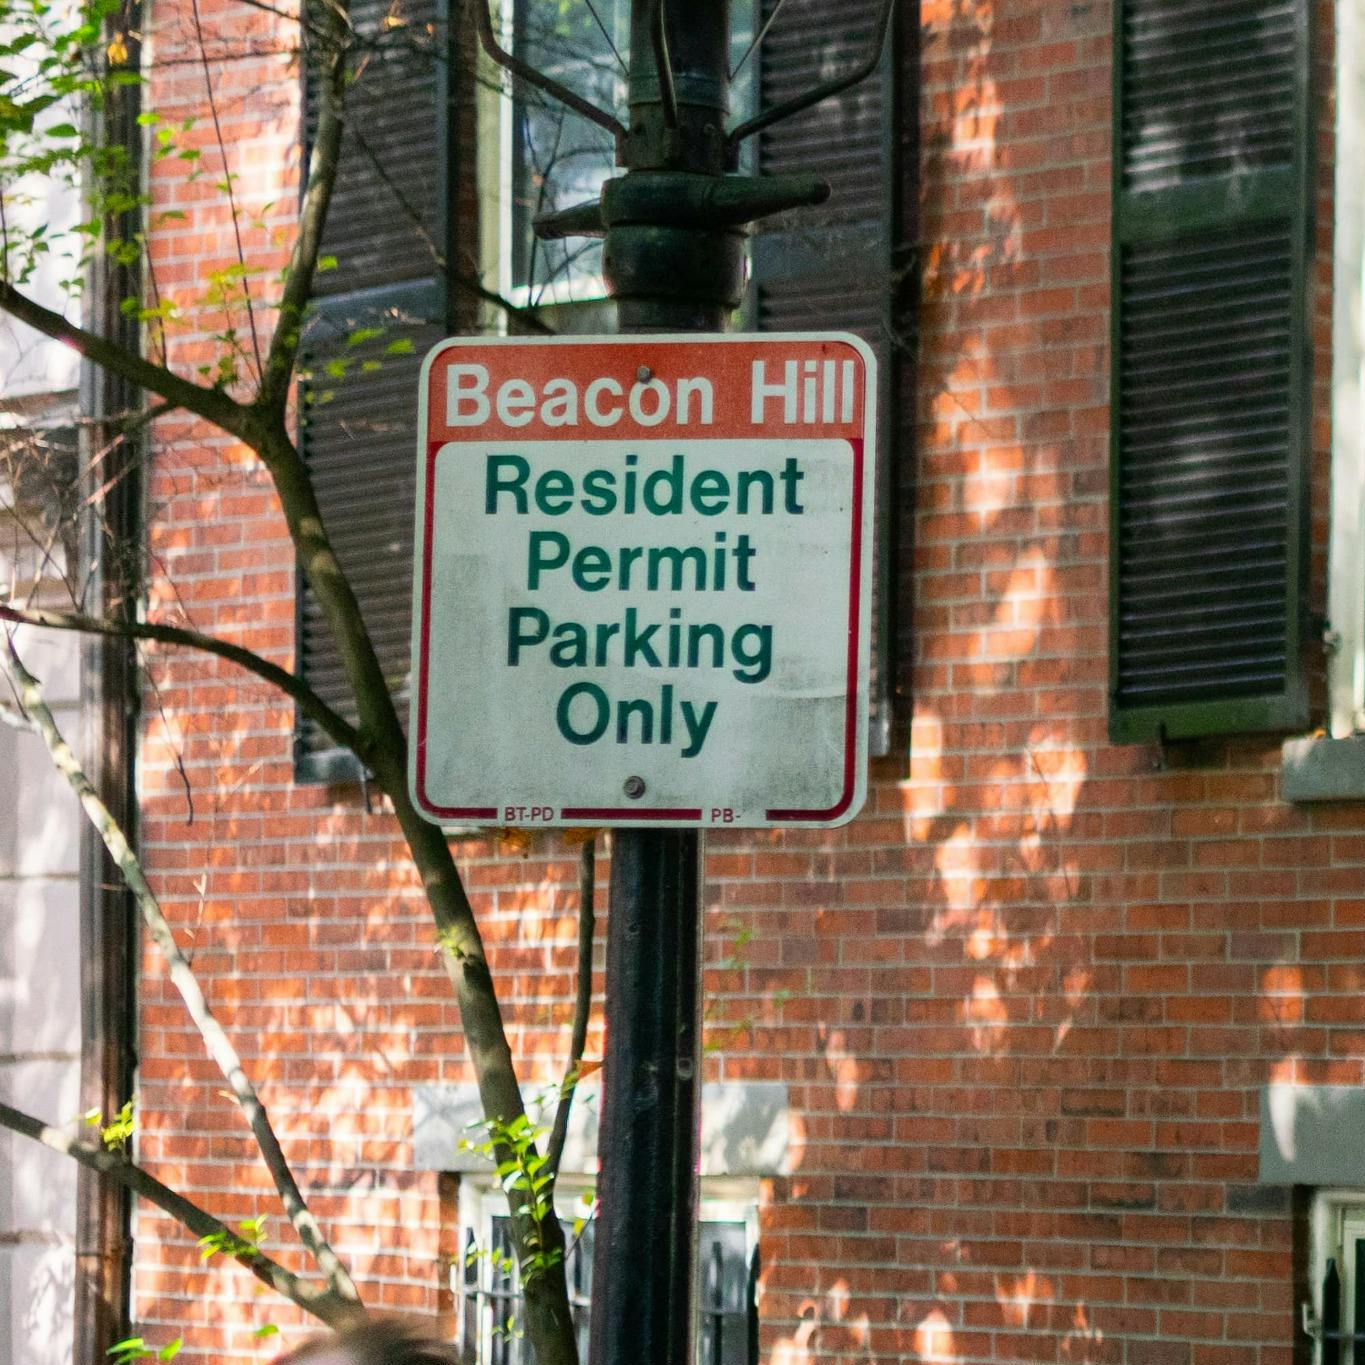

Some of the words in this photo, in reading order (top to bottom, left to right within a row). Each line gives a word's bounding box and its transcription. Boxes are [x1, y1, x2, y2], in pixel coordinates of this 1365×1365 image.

[445, 362, 714, 428] Beacon
[750, 359, 855, 425] Hill
[485, 454, 805, 516] Resident
[526, 530, 757, 592] Permit
[506, 607, 773, 684] Parking
[555, 681, 718, 759] Only
[504, 807, 555, 822] BT-PD
